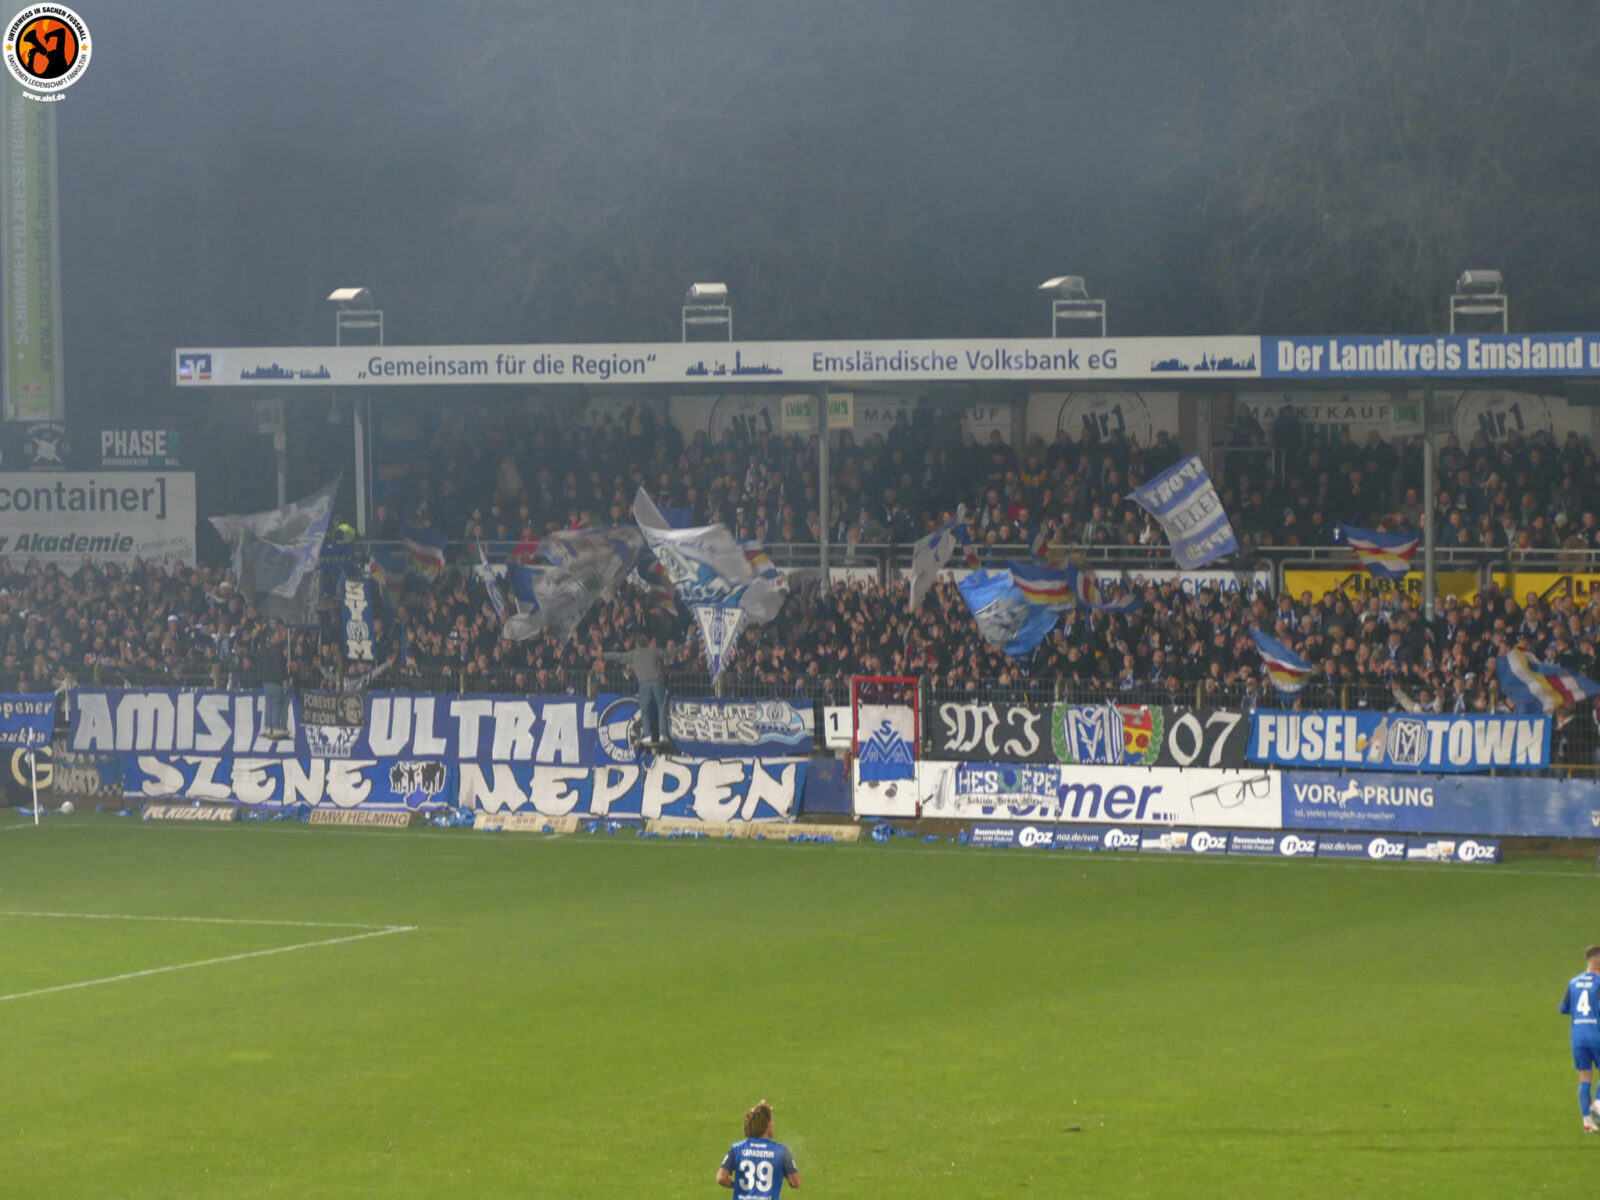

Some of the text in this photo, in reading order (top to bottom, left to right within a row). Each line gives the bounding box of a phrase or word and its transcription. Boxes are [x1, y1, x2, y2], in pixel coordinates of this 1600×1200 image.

[357, 355, 489, 380] „Gemeinsam
[495, 354, 526, 376] für
[532, 353, 565, 376] die
[812, 348, 1118, 373] Emsländische Volksbank eG
[1277, 339, 1324, 372] Der
[1328, 338, 1461, 371] Landkreis
[1467, 337, 1584, 370] Emsland
[1249, 406, 1390, 421] MAKTKAUF
[14, 533, 134, 553] Akademie
[0, 701, 53, 719] pener
[303, 693, 337, 709] FOREVER
[1168, 710, 1242, 768] 07
[1257, 714, 1545, 766] FUSEL TOWN
[137, 755, 797, 824] SZENE MEPPEN
[1293, 783, 1435, 808] VOR PRUNG
[312, 811, 408, 826] BMW HELMING
[1328, 808, 1357, 821] möglich
[1367, 810, 1396, 821] machen
[1577, 989, 1592, 1016] 4
[739, 1160, 774, 1192] 39
